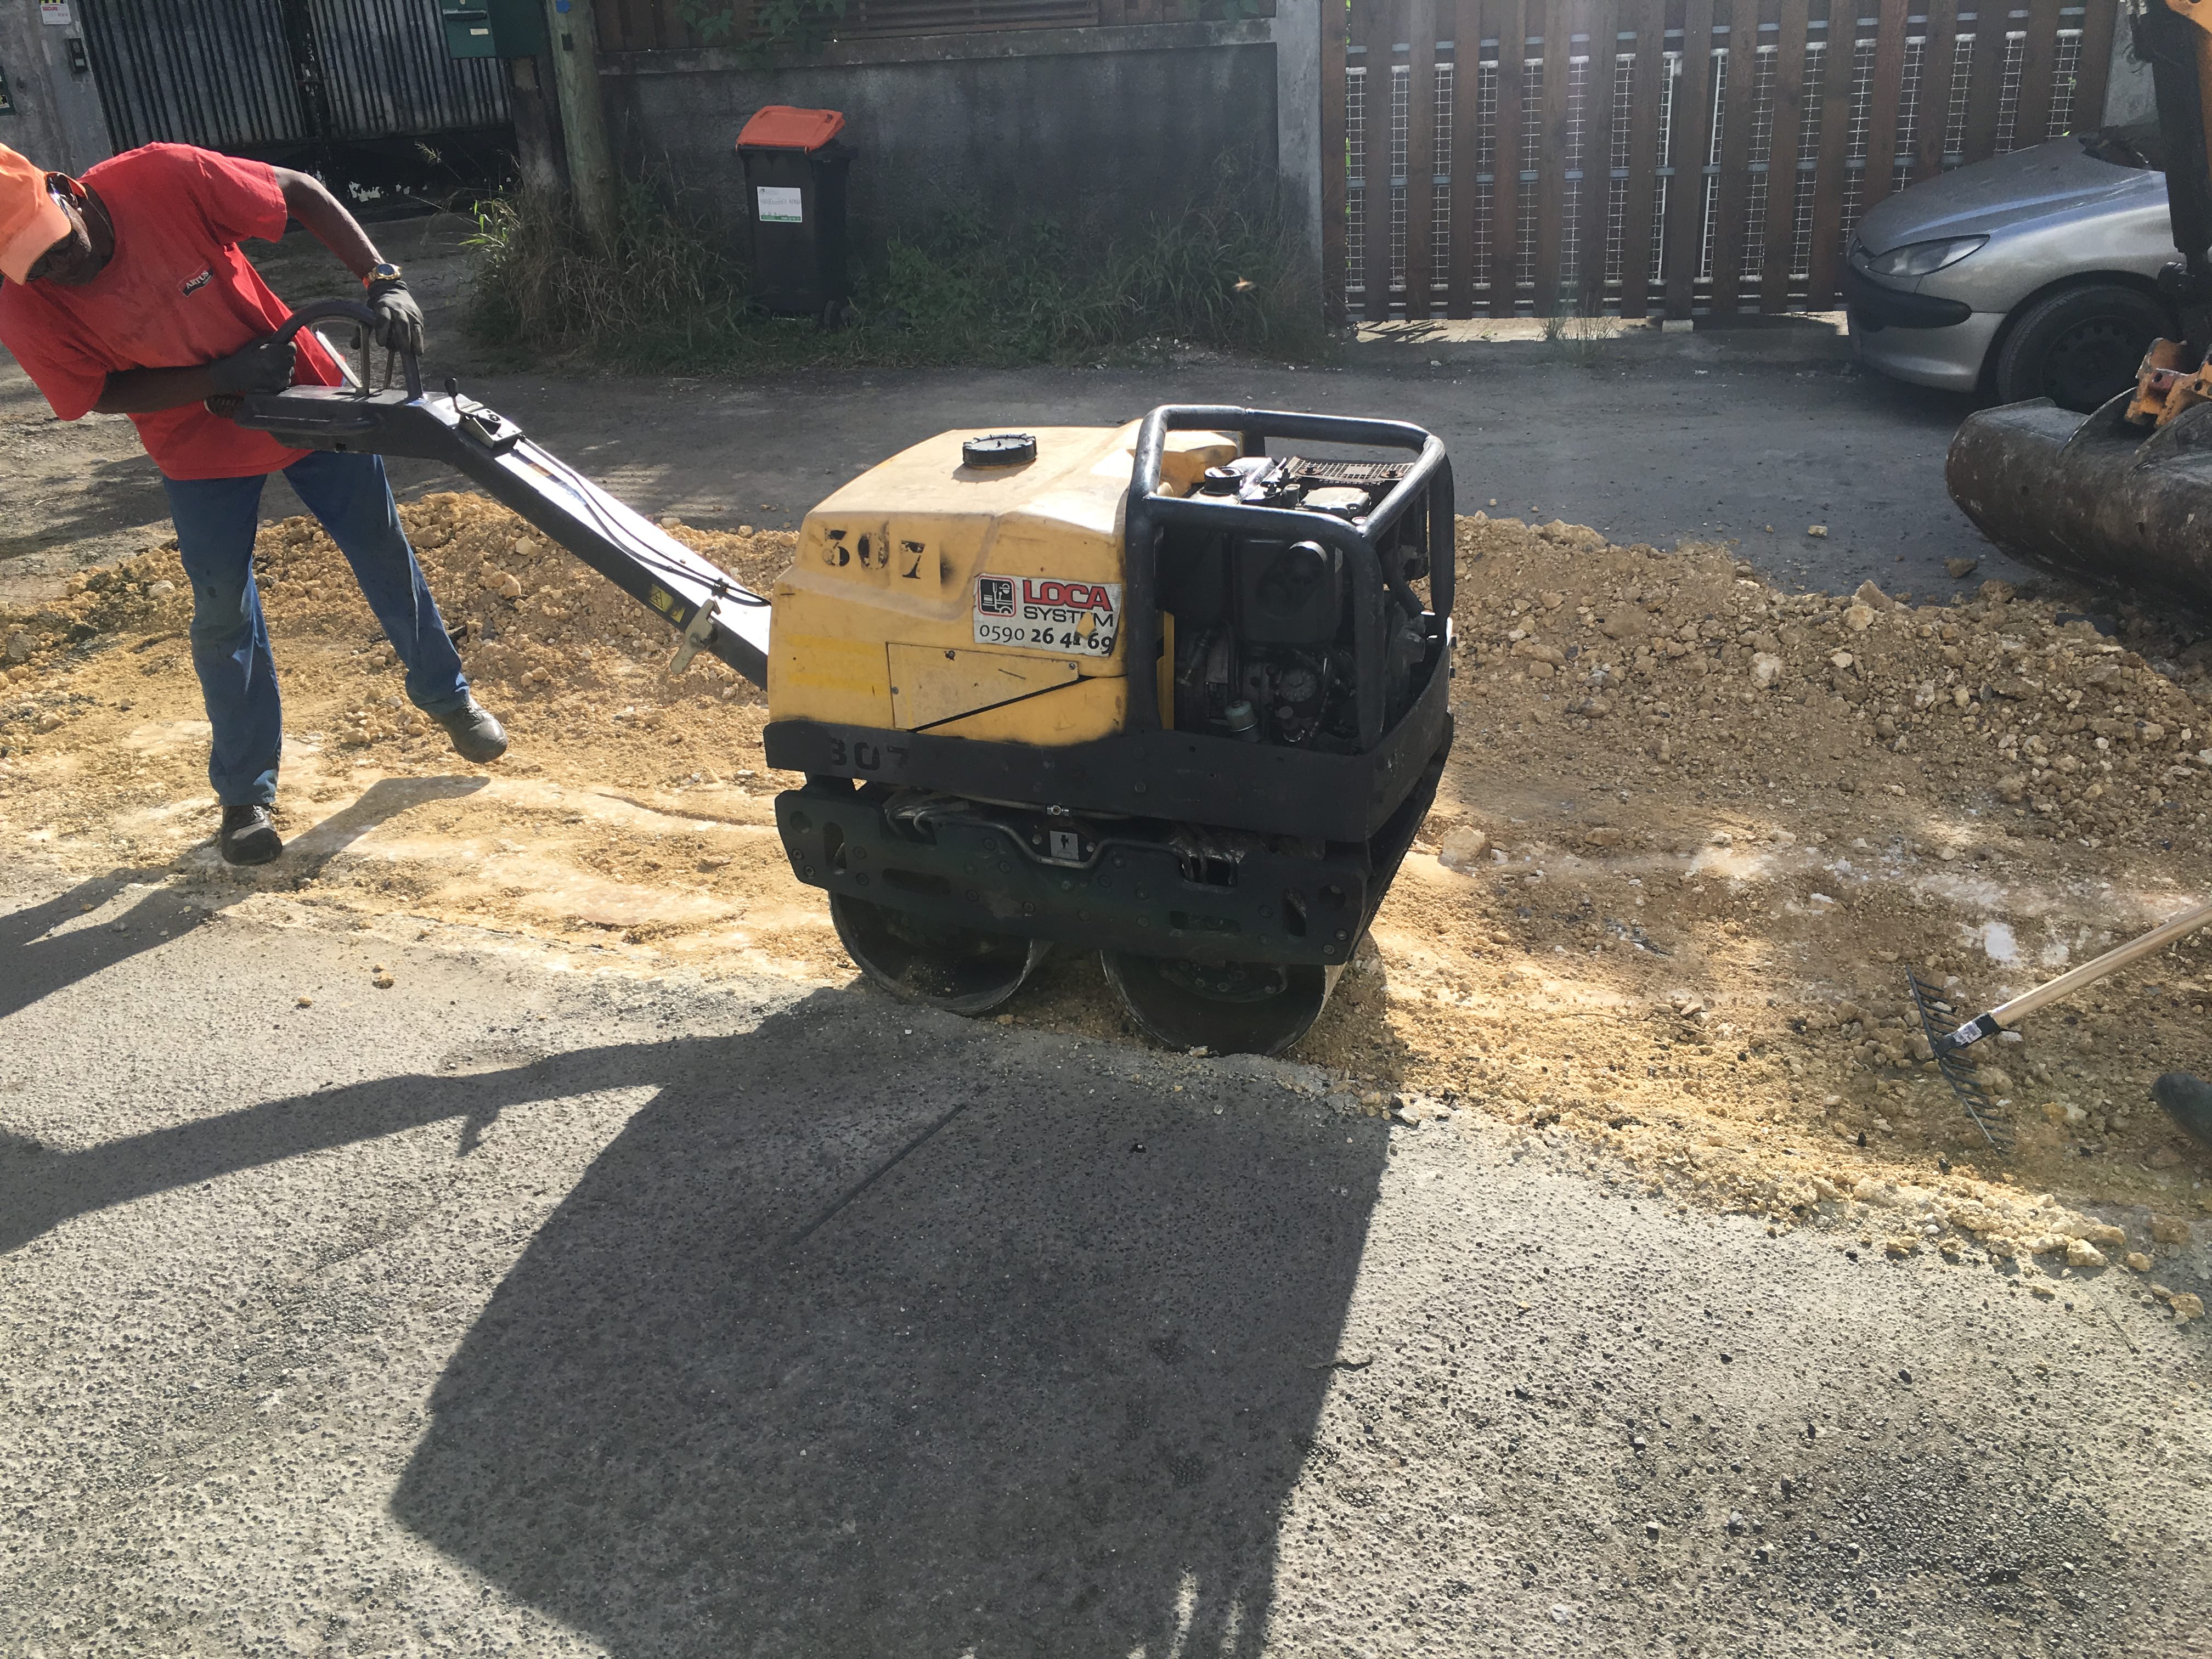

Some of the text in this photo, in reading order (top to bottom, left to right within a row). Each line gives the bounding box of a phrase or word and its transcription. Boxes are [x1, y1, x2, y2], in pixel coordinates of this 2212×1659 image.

[1022, 579, 1114, 612] LOCA
[1023, 606, 1114, 628] SYSTM
[979, 624, 1025, 643] 0590
[1031, 627, 1054, 645] 26
[1087, 633, 1113, 654] 69
